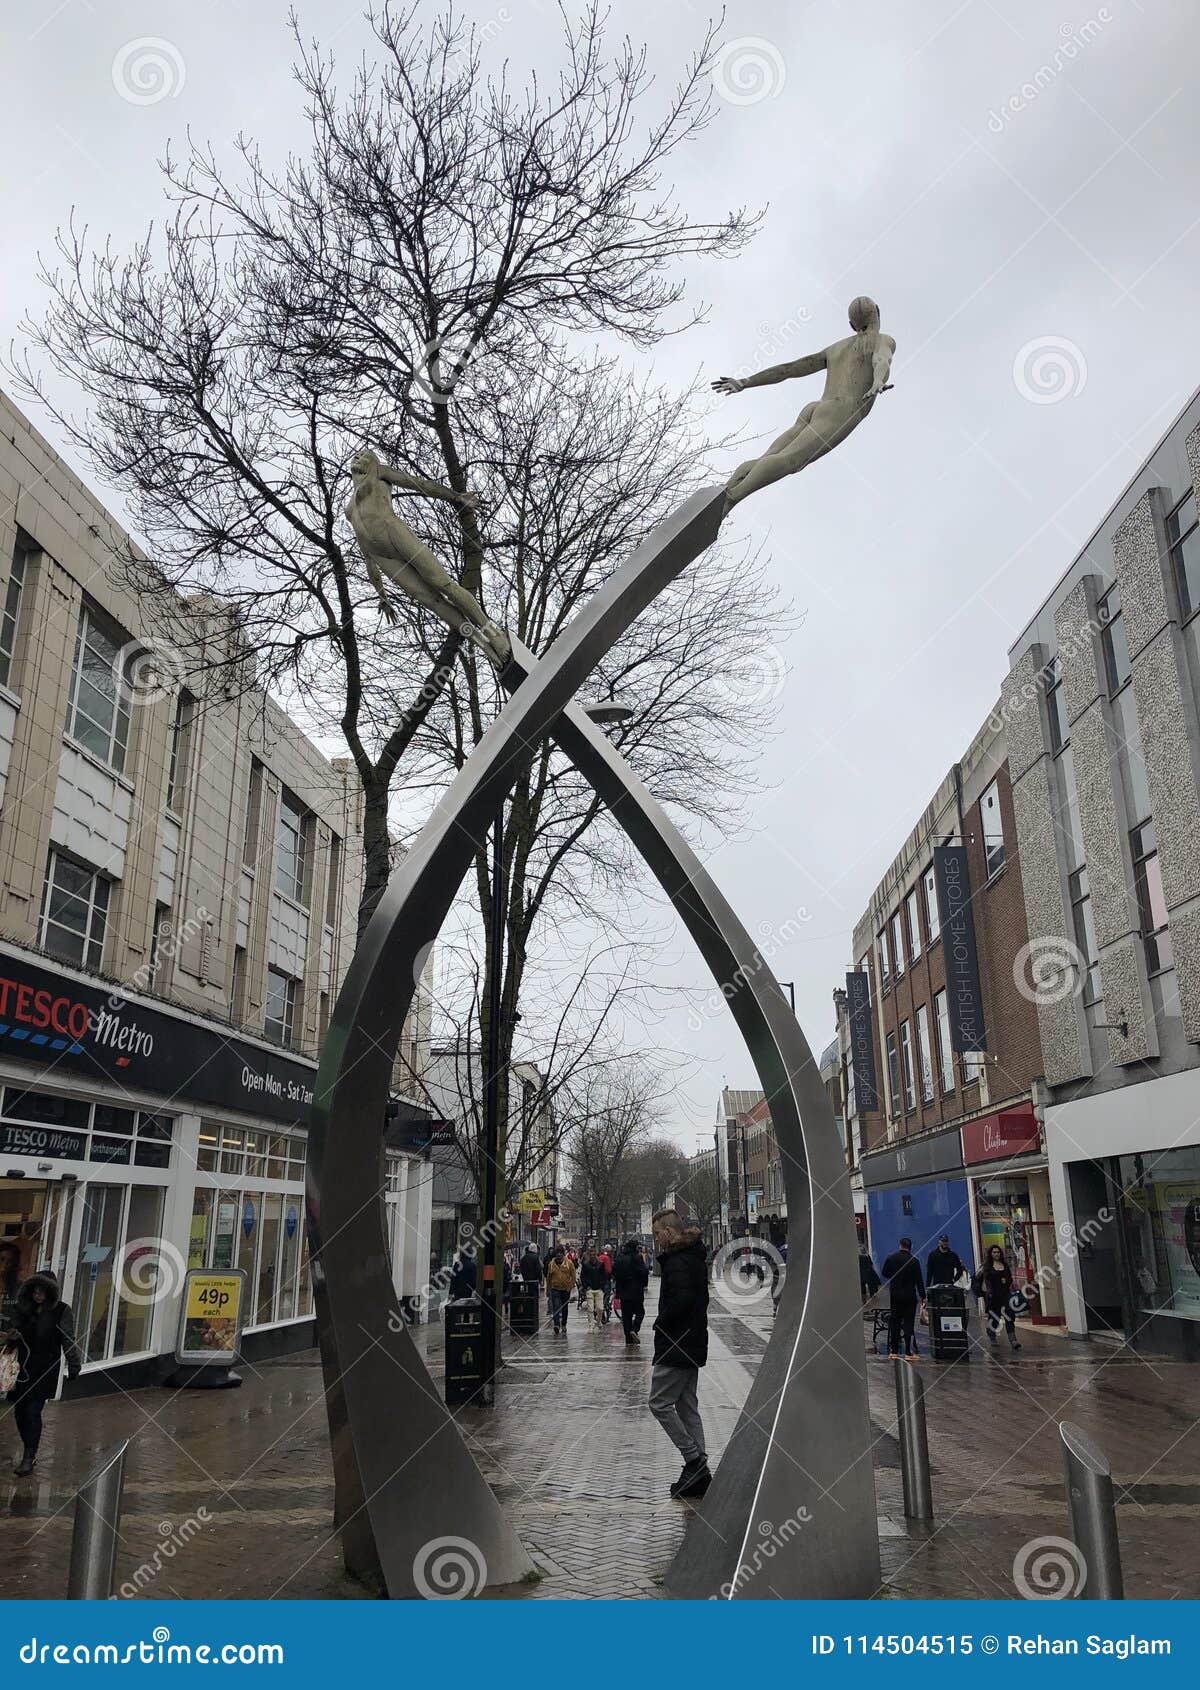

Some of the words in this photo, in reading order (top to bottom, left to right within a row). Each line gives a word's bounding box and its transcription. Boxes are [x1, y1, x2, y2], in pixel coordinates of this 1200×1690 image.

[944, 857, 963, 918] STORES
[951, 922, 970, 974] HOME
[0, 978, 88, 1037] TESCO
[94, 1011, 154, 1057] Metro
[853, 979, 865, 1021] STORES
[957, 980, 977, 1042] BRITISH
[856, 1024, 868, 1059] HOME
[242, 1066, 263, 1092] Open
[265, 1073, 281, 1096] Mon
[287, 1081, 300, 1101] Sat
[860, 1063, 872, 1105] BRITISH
[6, 1127, 47, 1147] TESCO
[49, 1134, 80, 1151] Metro
[198, 1288, 230, 1309] 49p
